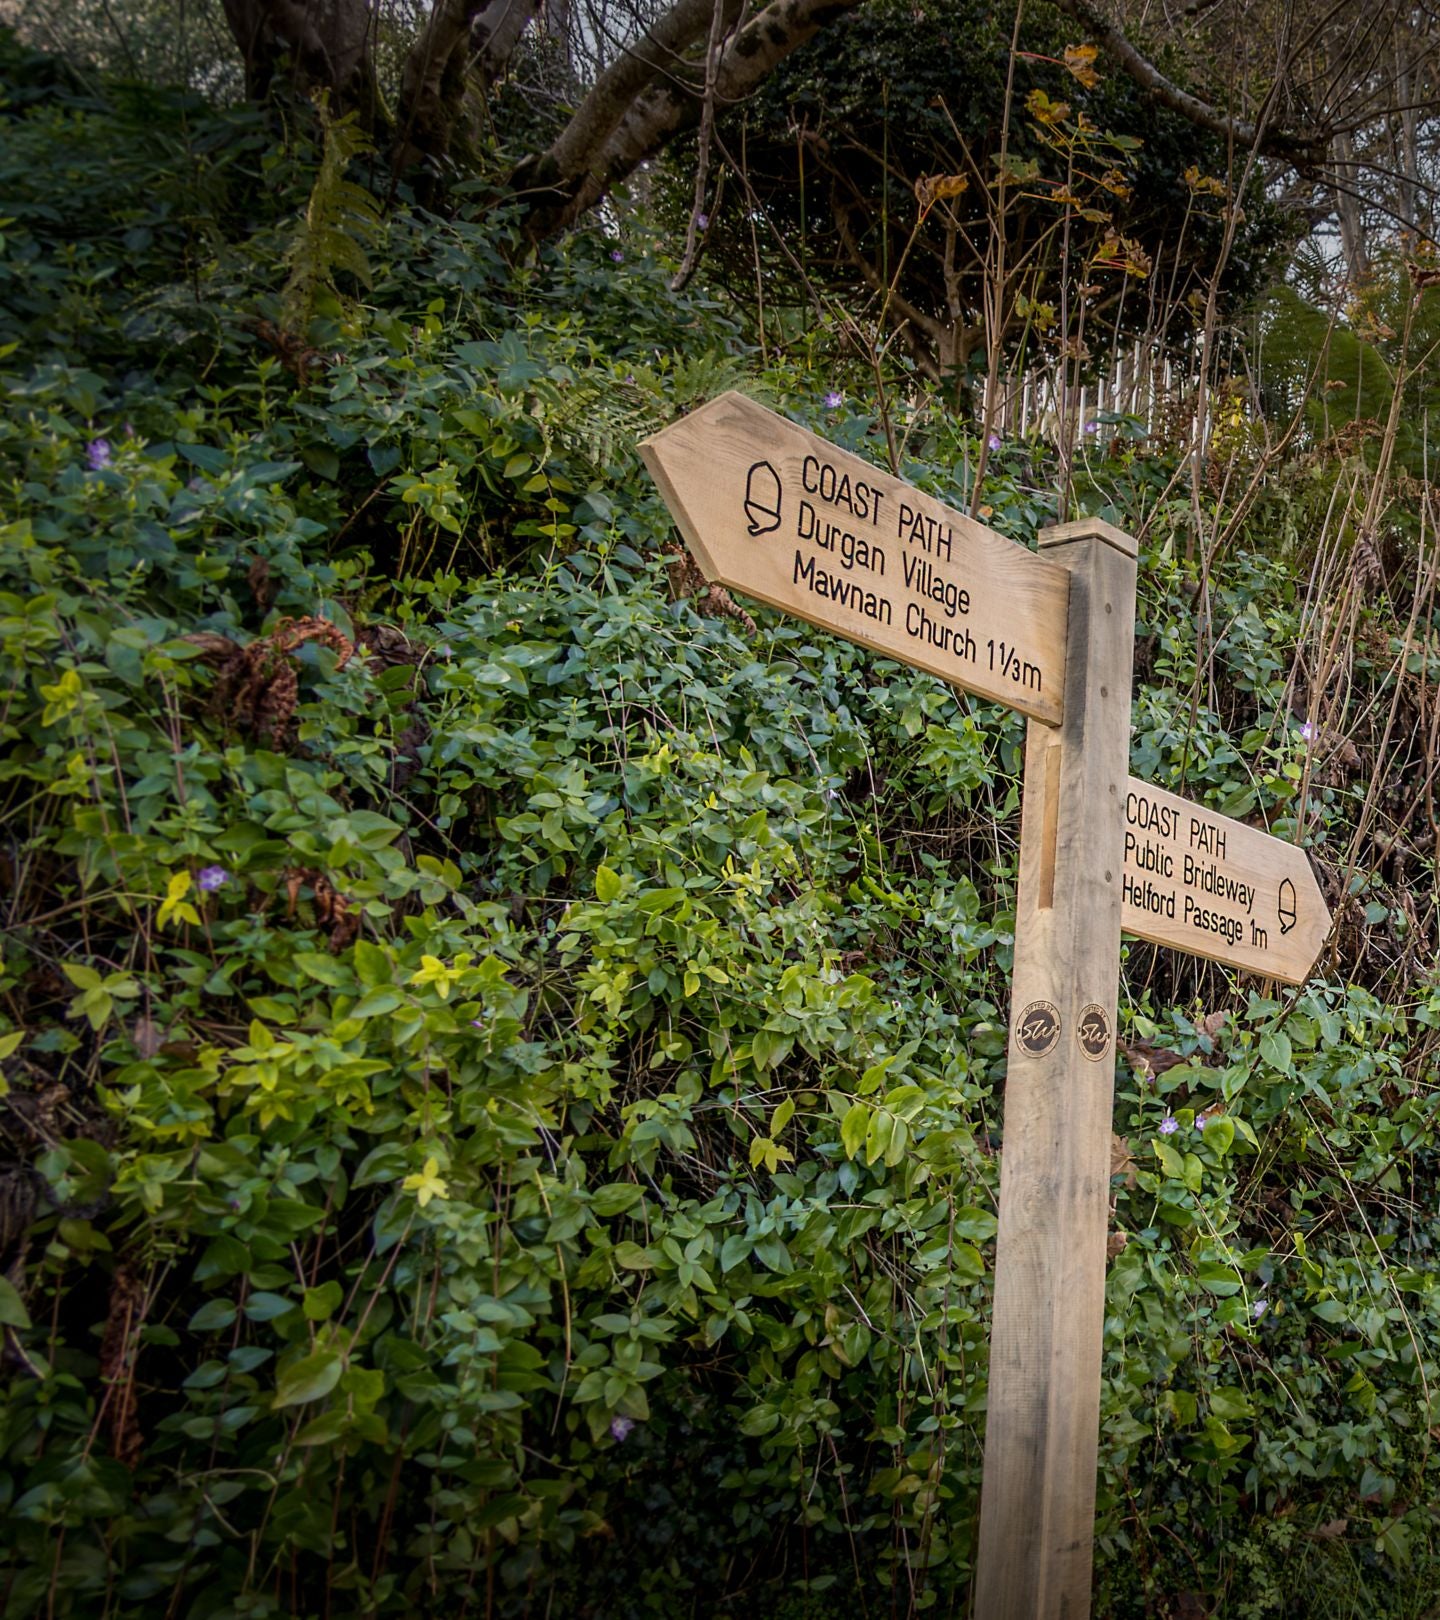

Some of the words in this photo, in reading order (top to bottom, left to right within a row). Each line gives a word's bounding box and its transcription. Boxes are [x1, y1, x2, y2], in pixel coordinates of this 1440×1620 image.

[802, 455, 884, 526] COAST
[898, 504, 953, 562] PATH
[793, 550, 892, 625] Mawnan
[905, 603, 976, 663] Church
[797, 501, 885, 576] Durgan
[902, 551, 971, 618] Village
[1124, 832, 1173, 878] Public
[1183, 855, 1256, 914] Bridleway
[1126, 793, 1180, 840] COAST
[1190, 818, 1226, 860] PATH
[1122, 874, 1176, 919] Helford
[1184, 896, 1243, 946] Passage
